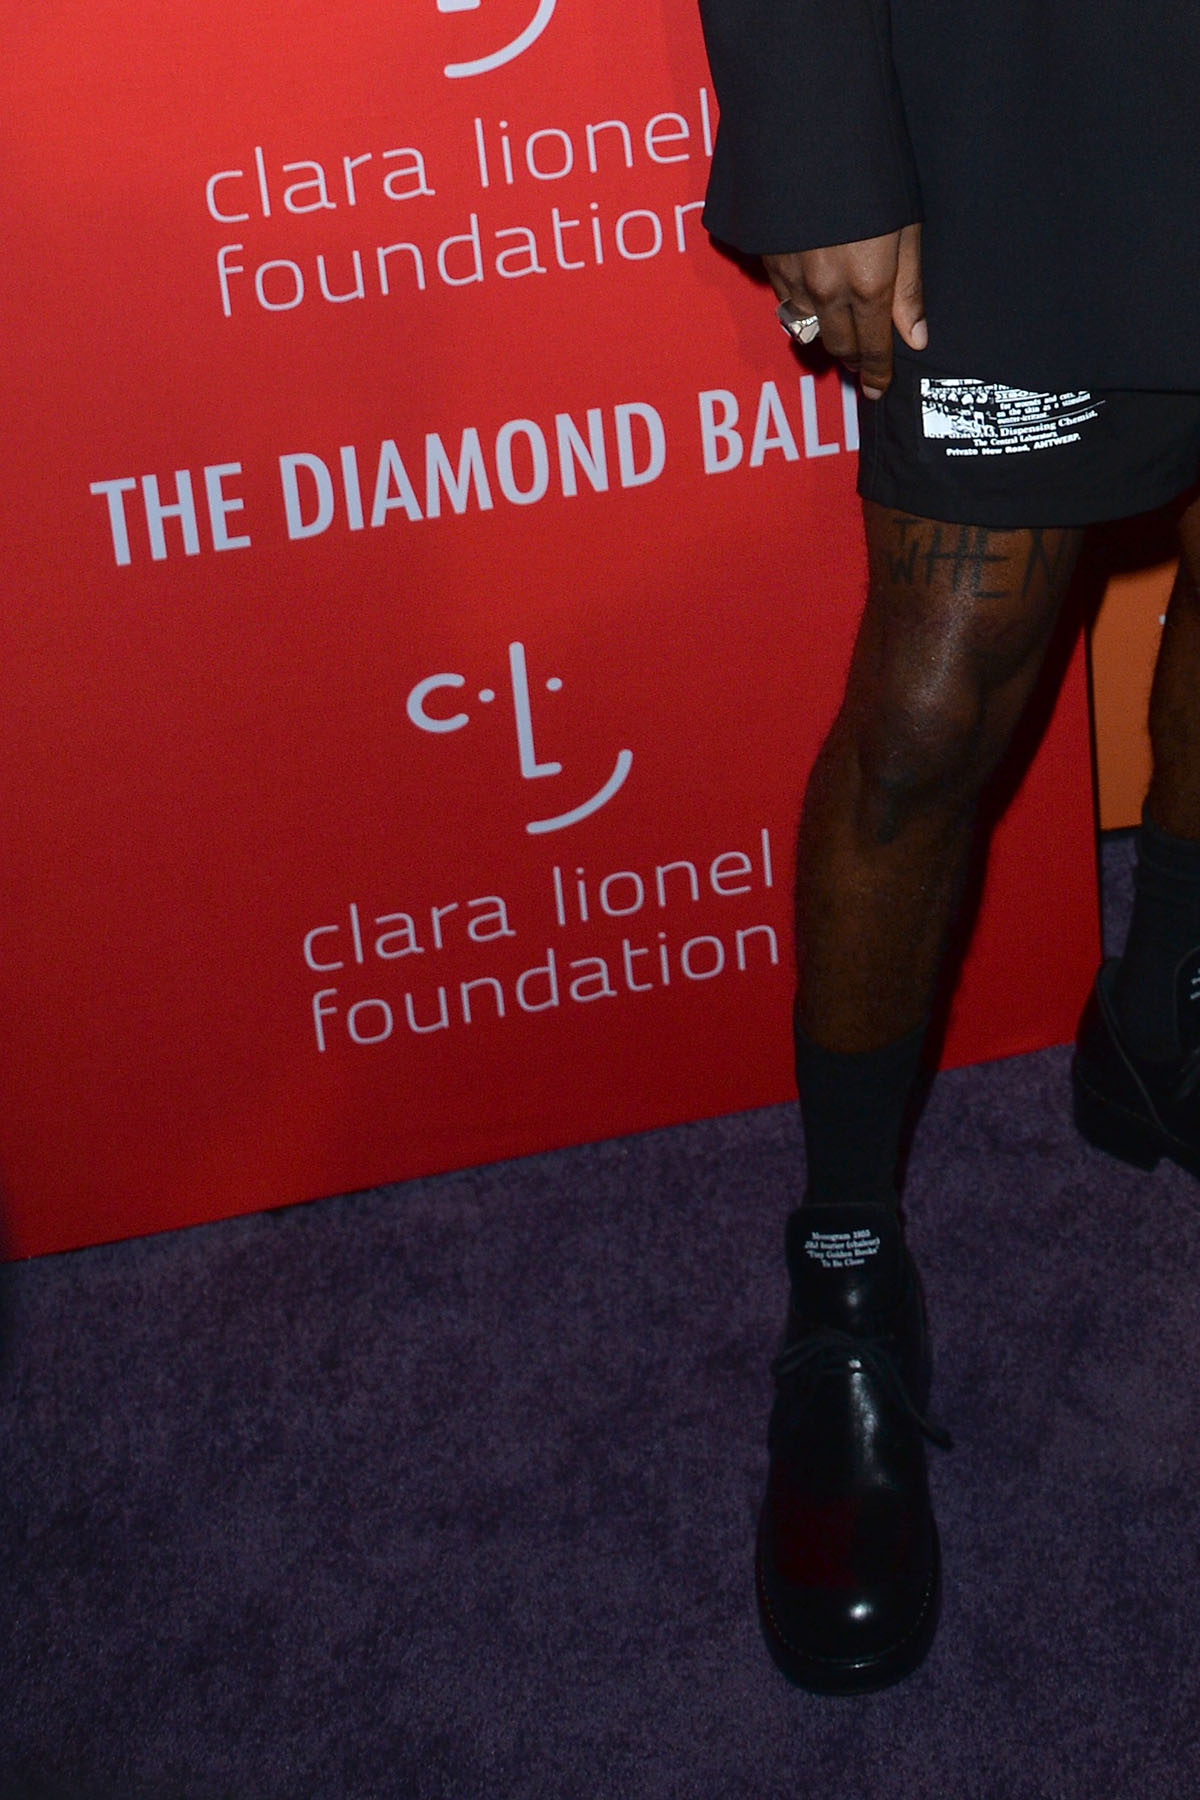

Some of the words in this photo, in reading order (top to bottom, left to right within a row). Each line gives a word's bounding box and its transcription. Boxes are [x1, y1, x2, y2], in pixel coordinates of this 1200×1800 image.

[205, 146, 436, 224] clara
[474, 87, 713, 188] lionel
[89, 461, 252, 566] THE
[278, 401, 666, 540] DIAMOND
[1000, 421, 1057, 438] Dispensing
[303, 903, 516, 973] clara
[552, 828, 775, 927] lionel
[312, 919, 780, 1053] foundation
